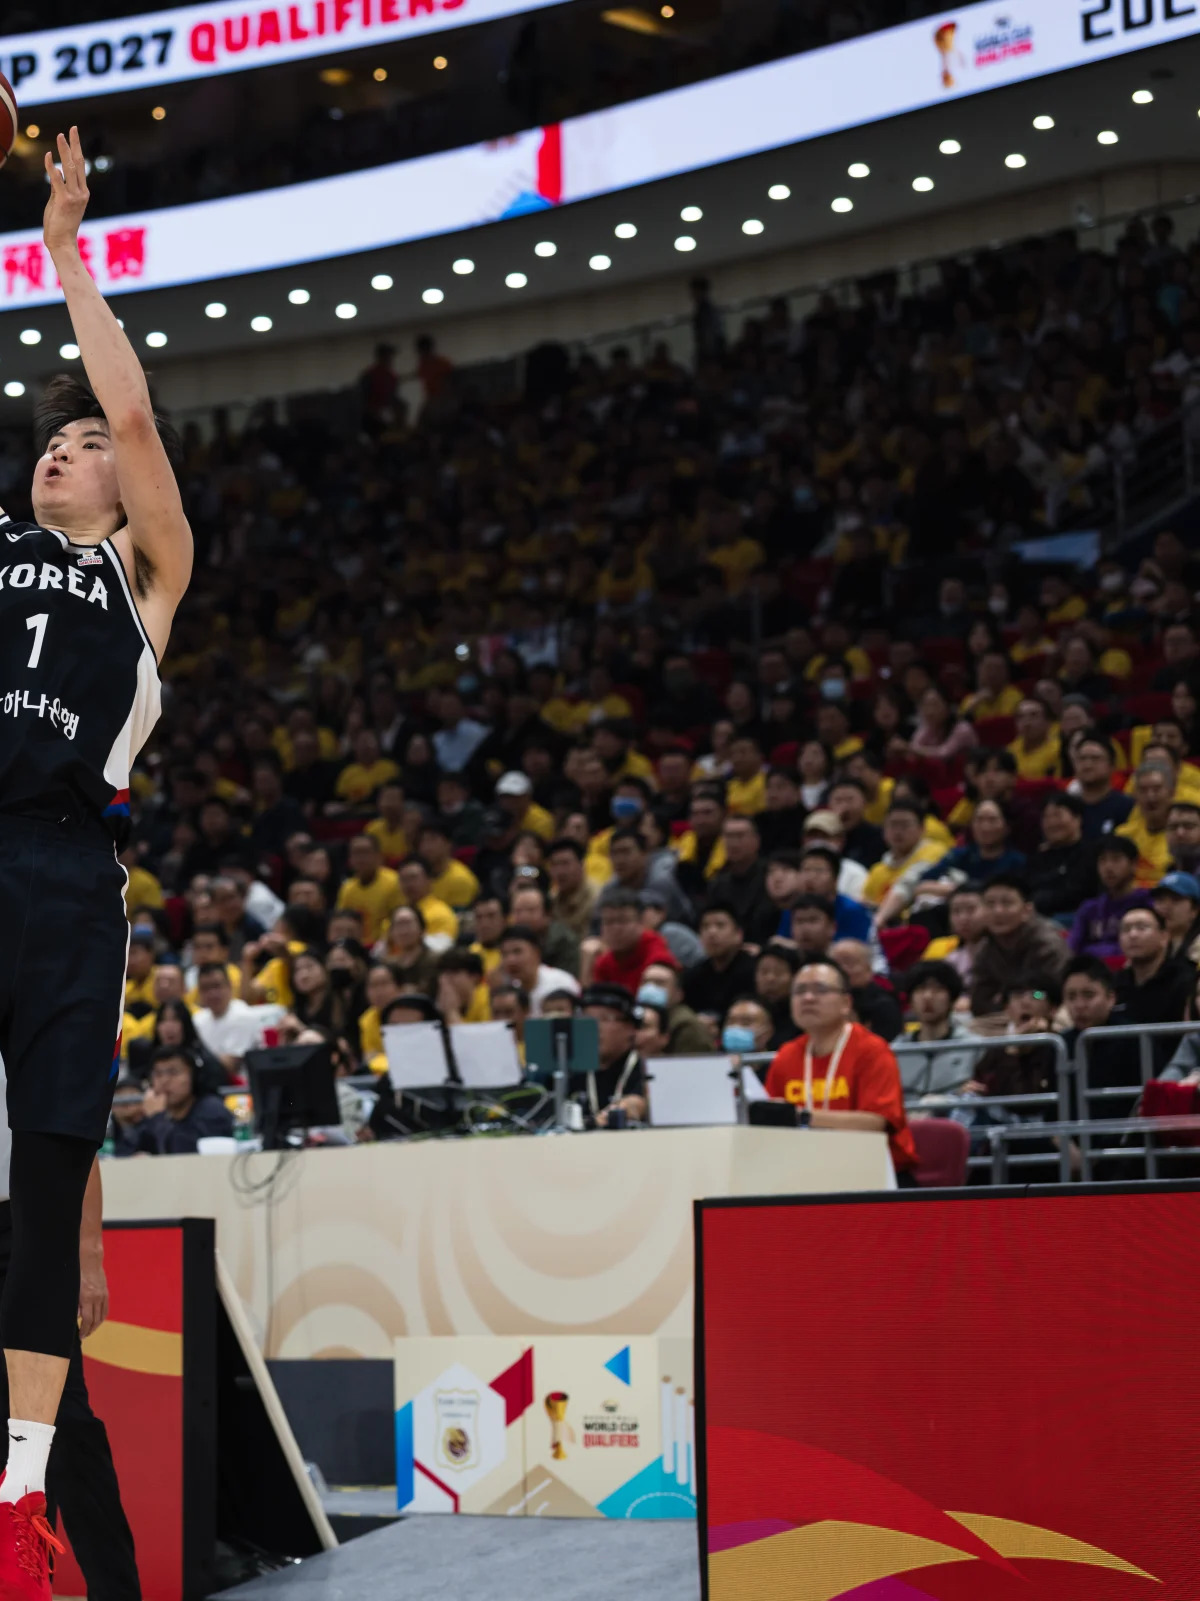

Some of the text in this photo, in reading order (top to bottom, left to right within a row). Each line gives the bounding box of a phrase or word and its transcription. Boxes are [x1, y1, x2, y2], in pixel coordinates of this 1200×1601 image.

[54, 28, 174, 82] 2027
[189, 0, 465, 63] QUALIFIE
[25, 613, 49, 669] 1
[3, 689, 80, 741] 하나은행
[583, 1433, 639, 1448] QUALIFIERS
[584, 1422, 639, 1432] WORLD CUP
